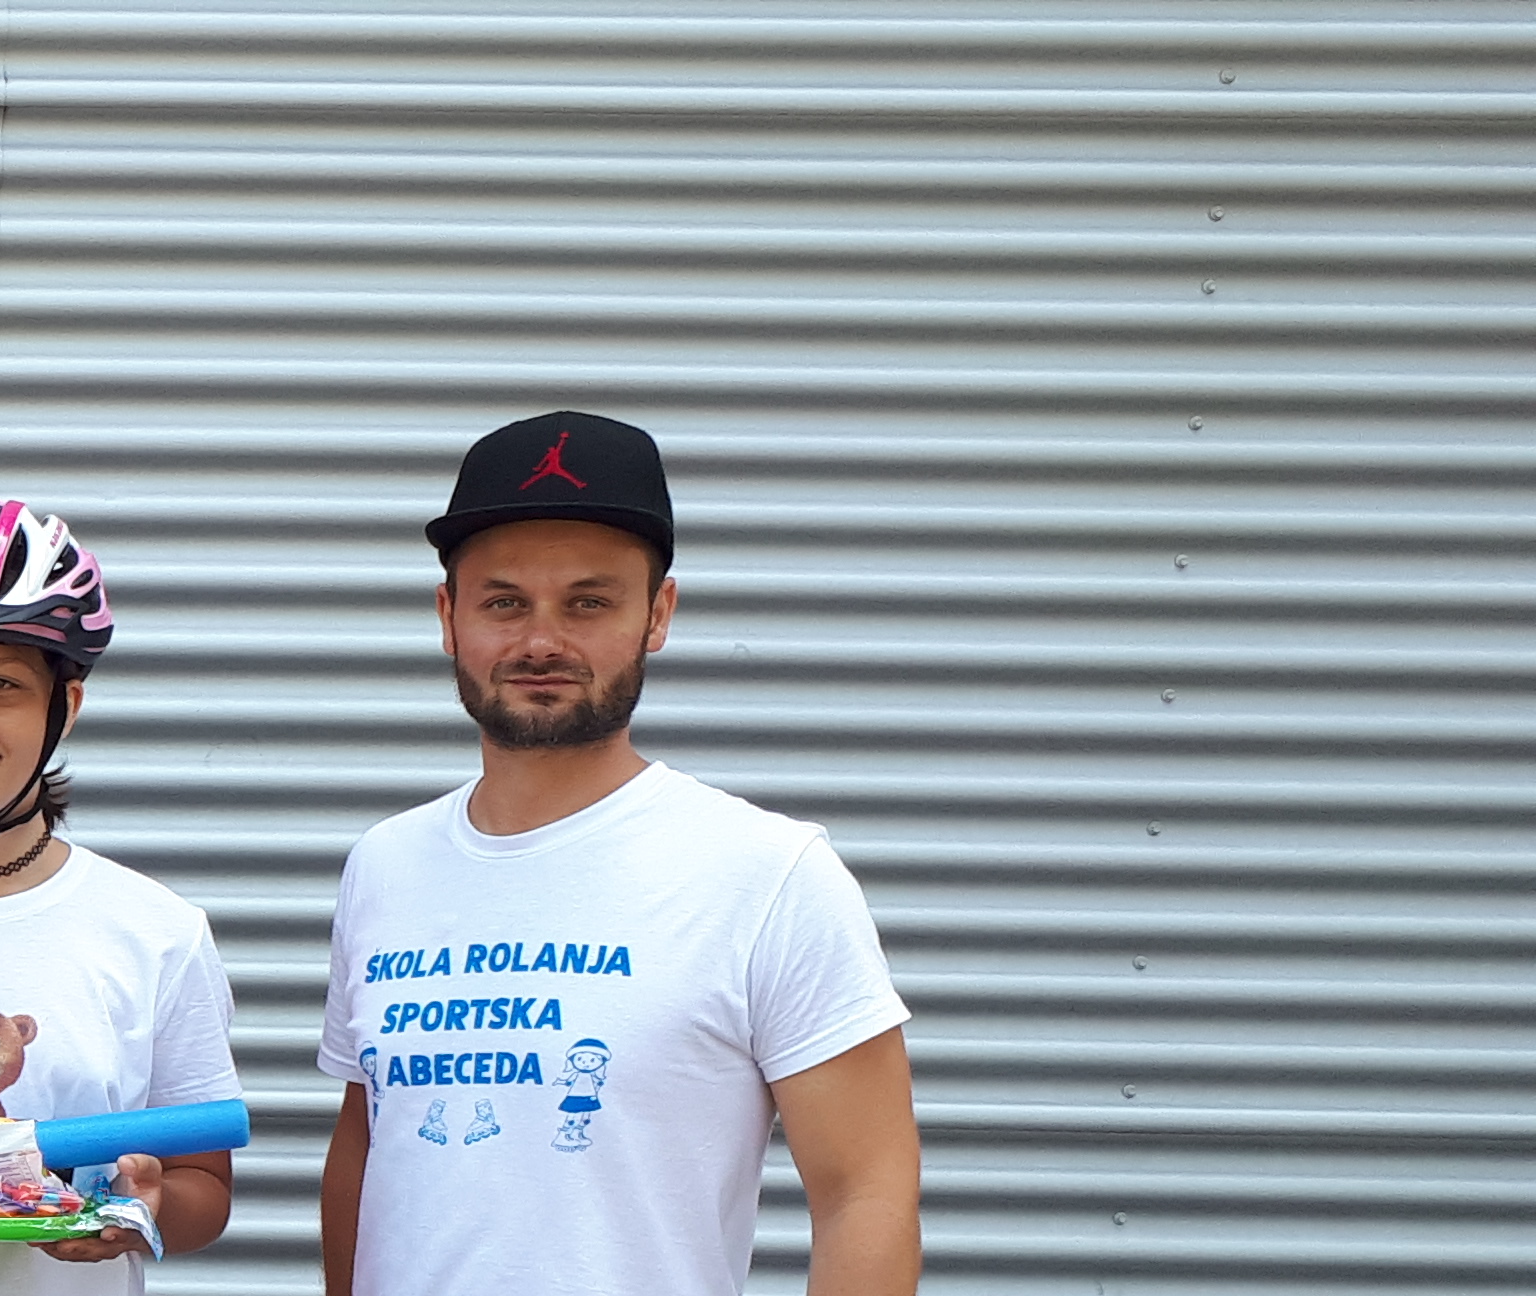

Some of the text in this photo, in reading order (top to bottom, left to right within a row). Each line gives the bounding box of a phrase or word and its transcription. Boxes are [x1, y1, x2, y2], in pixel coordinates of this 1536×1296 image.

[364, 942, 632, 983] ŠKOLA ROLANJA
[380, 997, 563, 1034] SPORTSKA
[386, 1052, 544, 1087] ABECEDA
